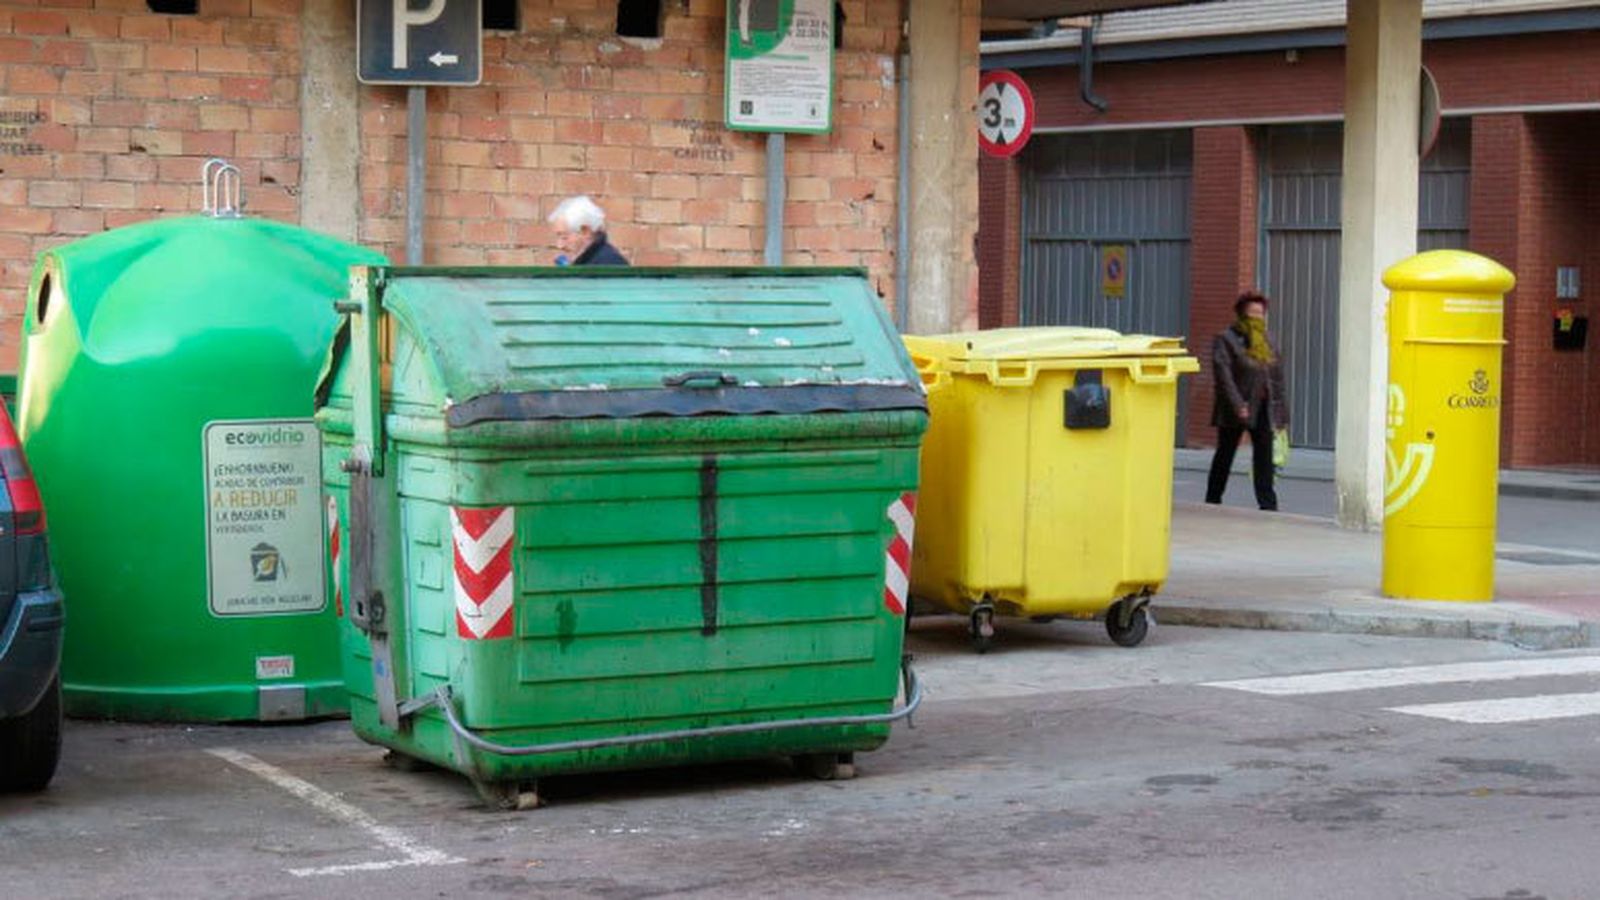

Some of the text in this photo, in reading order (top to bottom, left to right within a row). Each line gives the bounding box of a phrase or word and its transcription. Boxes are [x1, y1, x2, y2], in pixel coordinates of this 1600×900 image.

[392, 0, 447, 69] P
[984, 99, 1001, 127] 3
[225, 426, 305, 445] ecovidrio
[213, 488, 298, 508] A REDUCIR
